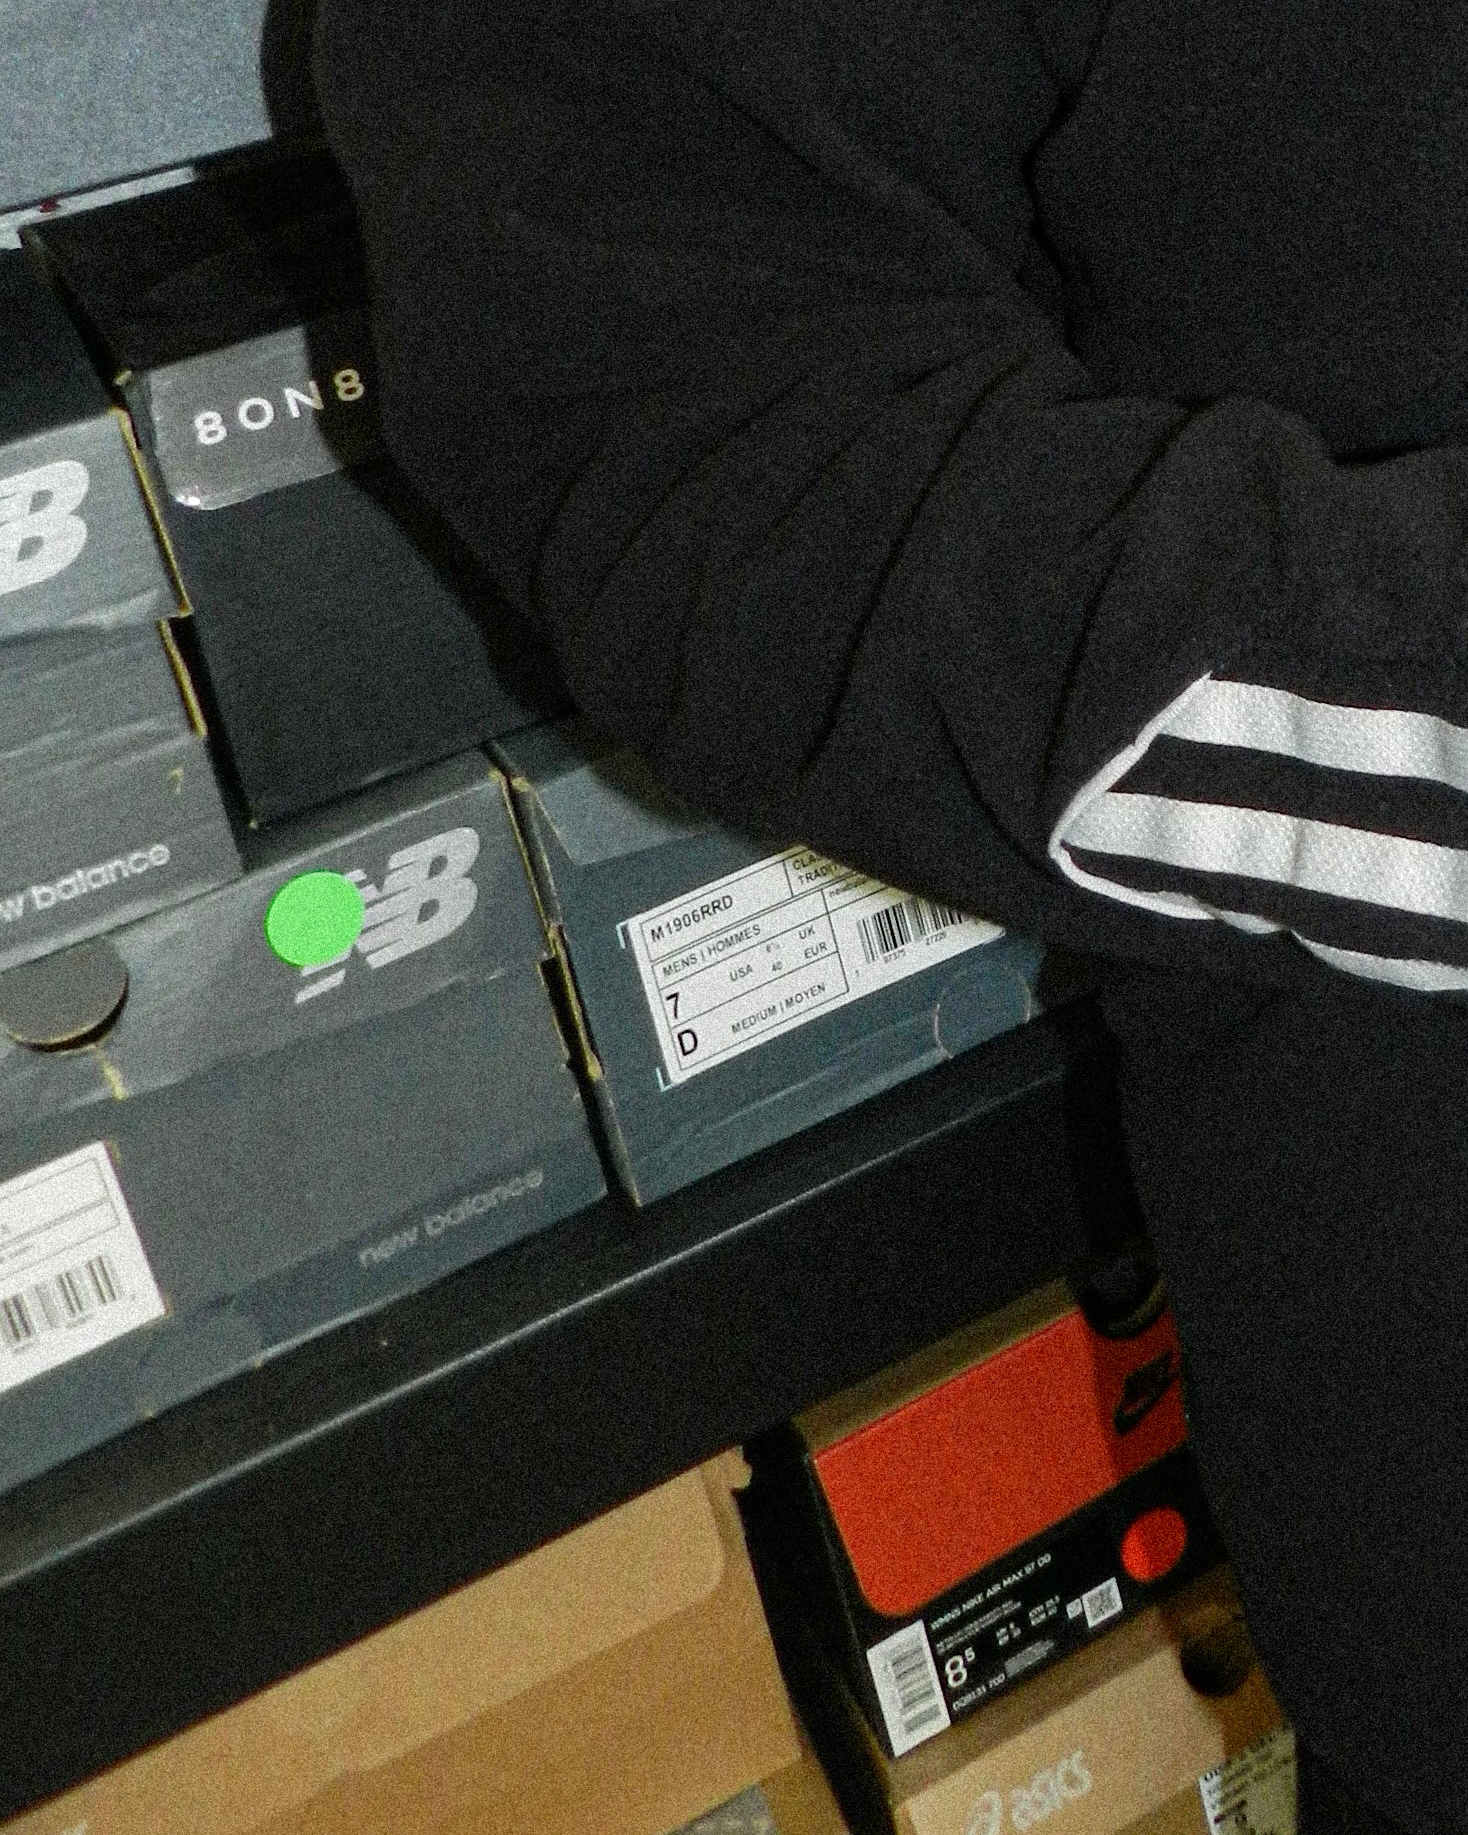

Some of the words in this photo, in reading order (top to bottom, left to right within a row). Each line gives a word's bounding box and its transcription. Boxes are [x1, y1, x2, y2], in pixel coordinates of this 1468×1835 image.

[32, 843, 171, 910] balance
[650, 894, 734, 943] M1906RRD
[662, 955, 698, 977] MENS
[708, 924, 762, 958] HOMMES
[666, 992, 681, 1020] 7
[729, 964, 754, 983] USA
[798, 926, 816, 941] UK
[804, 941, 828, 960] EUR
[677, 1028, 699, 1057] D
[731, 1004, 778, 1034] MEDIUM
[785, 982, 827, 1009] MOYEN
[424, 1168, 544, 1236] balance
[1002, 1571, 1024, 1587] MAX
